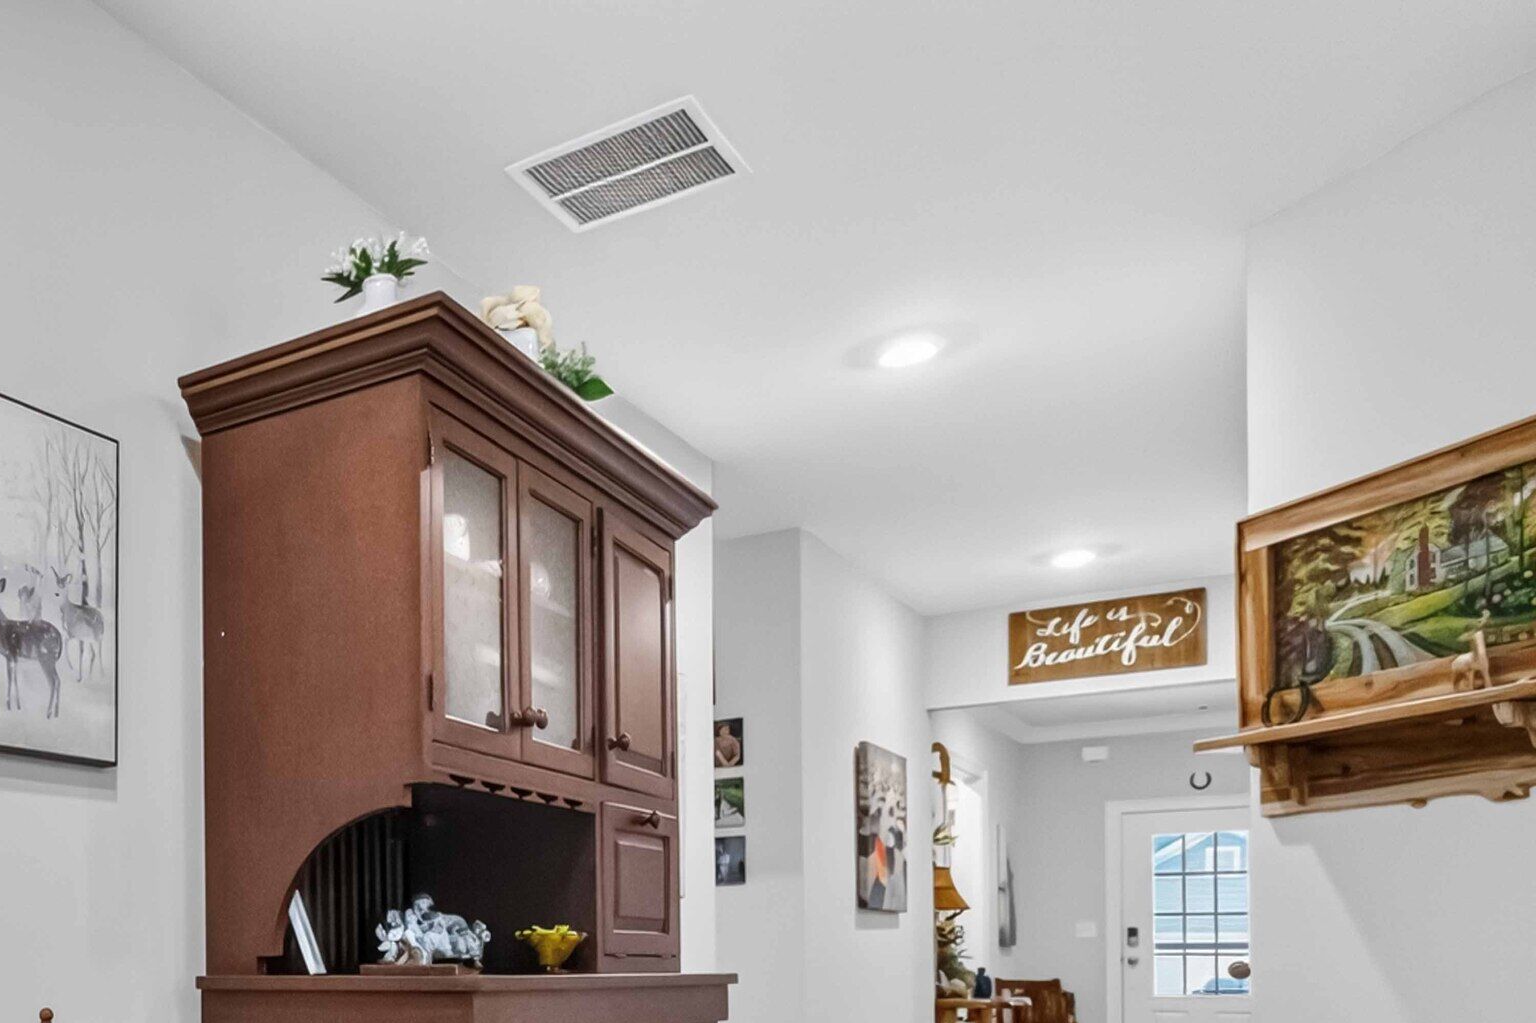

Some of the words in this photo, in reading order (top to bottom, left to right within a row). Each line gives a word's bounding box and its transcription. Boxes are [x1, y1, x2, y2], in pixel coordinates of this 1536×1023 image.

[1015, 615, 1186, 666] Beautiful
[1036, 608, 1099, 644] Life
[1107, 605, 1145, 622] is
